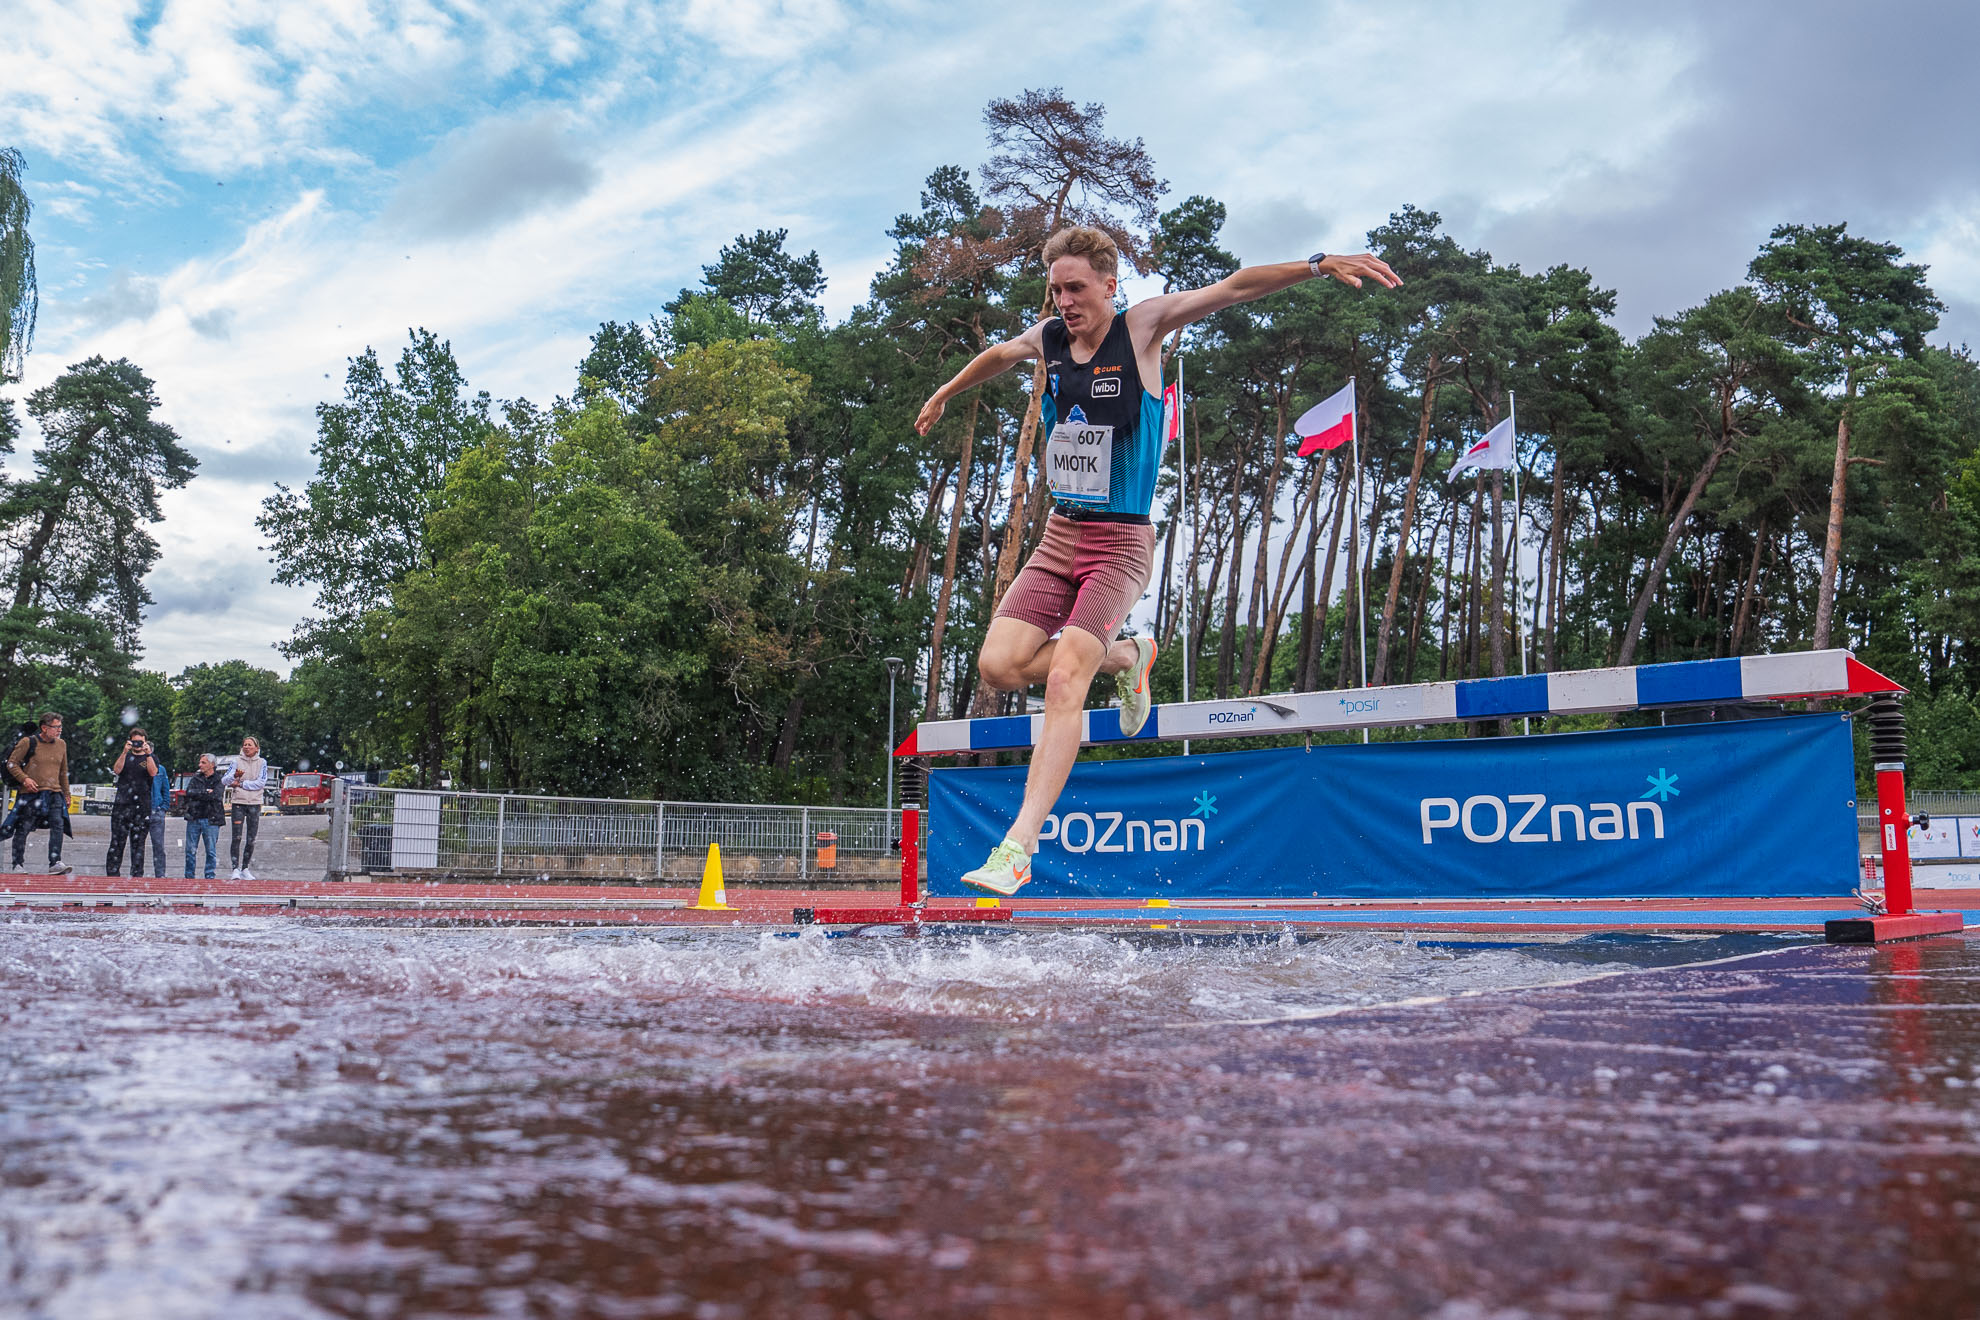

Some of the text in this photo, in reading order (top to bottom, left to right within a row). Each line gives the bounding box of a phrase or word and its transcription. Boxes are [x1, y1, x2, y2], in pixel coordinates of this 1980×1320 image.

[1095, 383, 1116, 393] wibo
[1077, 430, 1105, 446] 607
[1053, 453, 1098, 473] MIOTK
[1345, 697, 1380, 716] posir
[1208, 712, 1254, 724] POZnan
[1420, 794, 1665, 844] POZnan
[1032, 811, 1206, 854] POZnan
